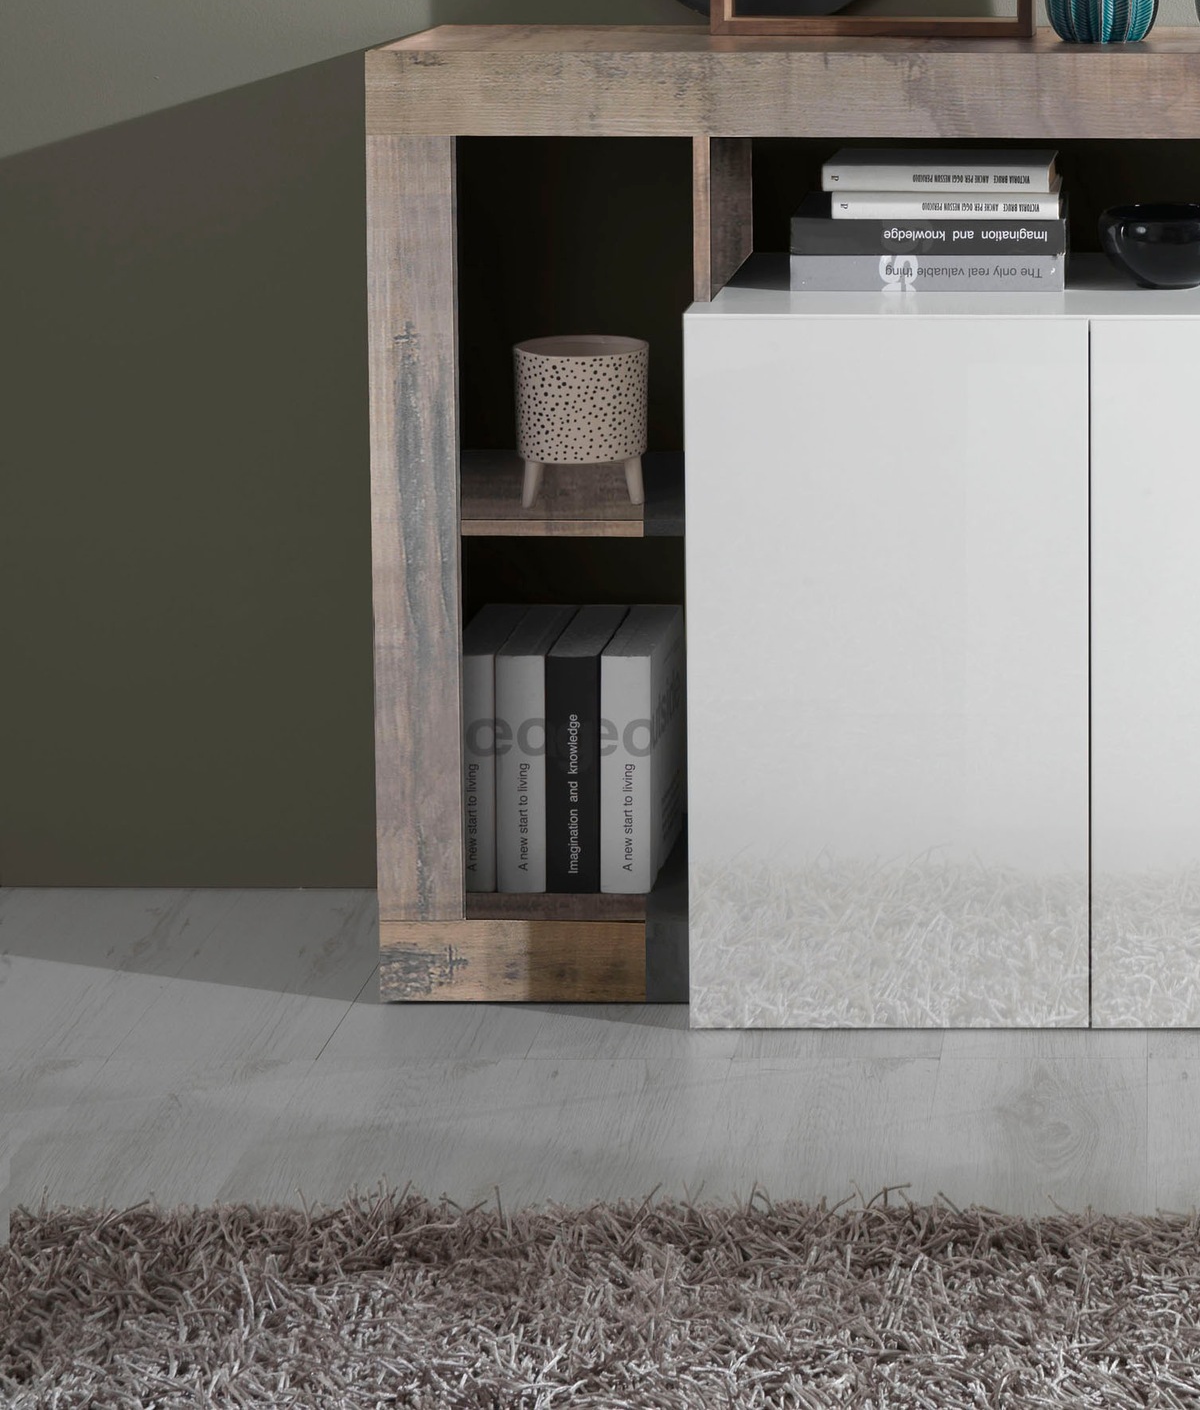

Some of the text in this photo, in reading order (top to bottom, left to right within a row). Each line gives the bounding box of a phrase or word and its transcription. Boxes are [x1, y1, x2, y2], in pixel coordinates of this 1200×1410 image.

[965, 174, 974, 184] PER
[975, 174, 989, 184] ANCHE
[994, 174, 1008, 184] BRUCE
[1009, 175, 1030, 184] VICTORIA
[974, 202, 984, 212] PER
[984, 202, 999, 212] ANCHE
[1003, 203, 1018, 212] BRUCE
[1019, 203, 1040, 212] VICTORIA
[883, 228, 1048, 242] Imagination and knowledge
[885, 265, 1043, 278] The only real valuable thing
[567, 714, 581, 874] Imagination and knowledge
[467, 763, 479, 871] A new start to living
[518, 763, 530, 871] A new start to living
[623, 763, 635, 871] A new start to living
